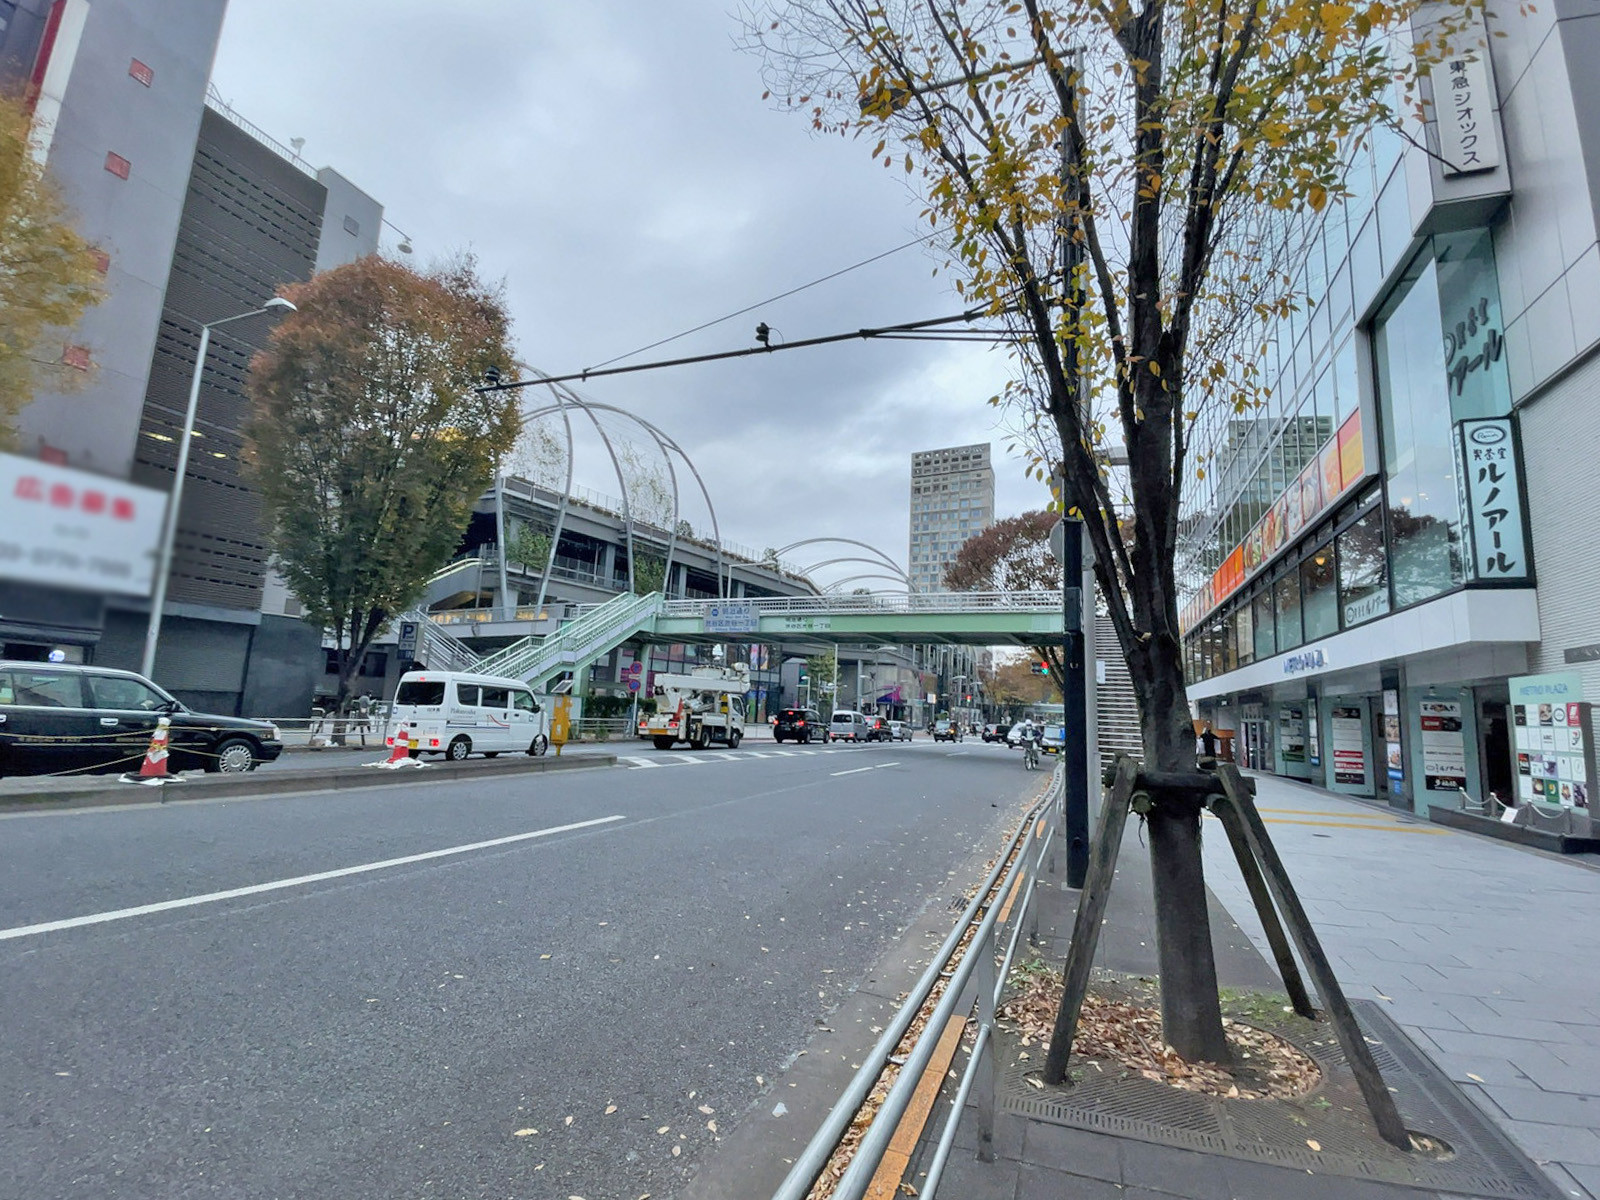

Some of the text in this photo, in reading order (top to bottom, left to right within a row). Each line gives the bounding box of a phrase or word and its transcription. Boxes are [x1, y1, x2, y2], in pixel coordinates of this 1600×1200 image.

[1448, 329, 1503, 396] アール
[1478, 462, 1516, 573] ルノアール
